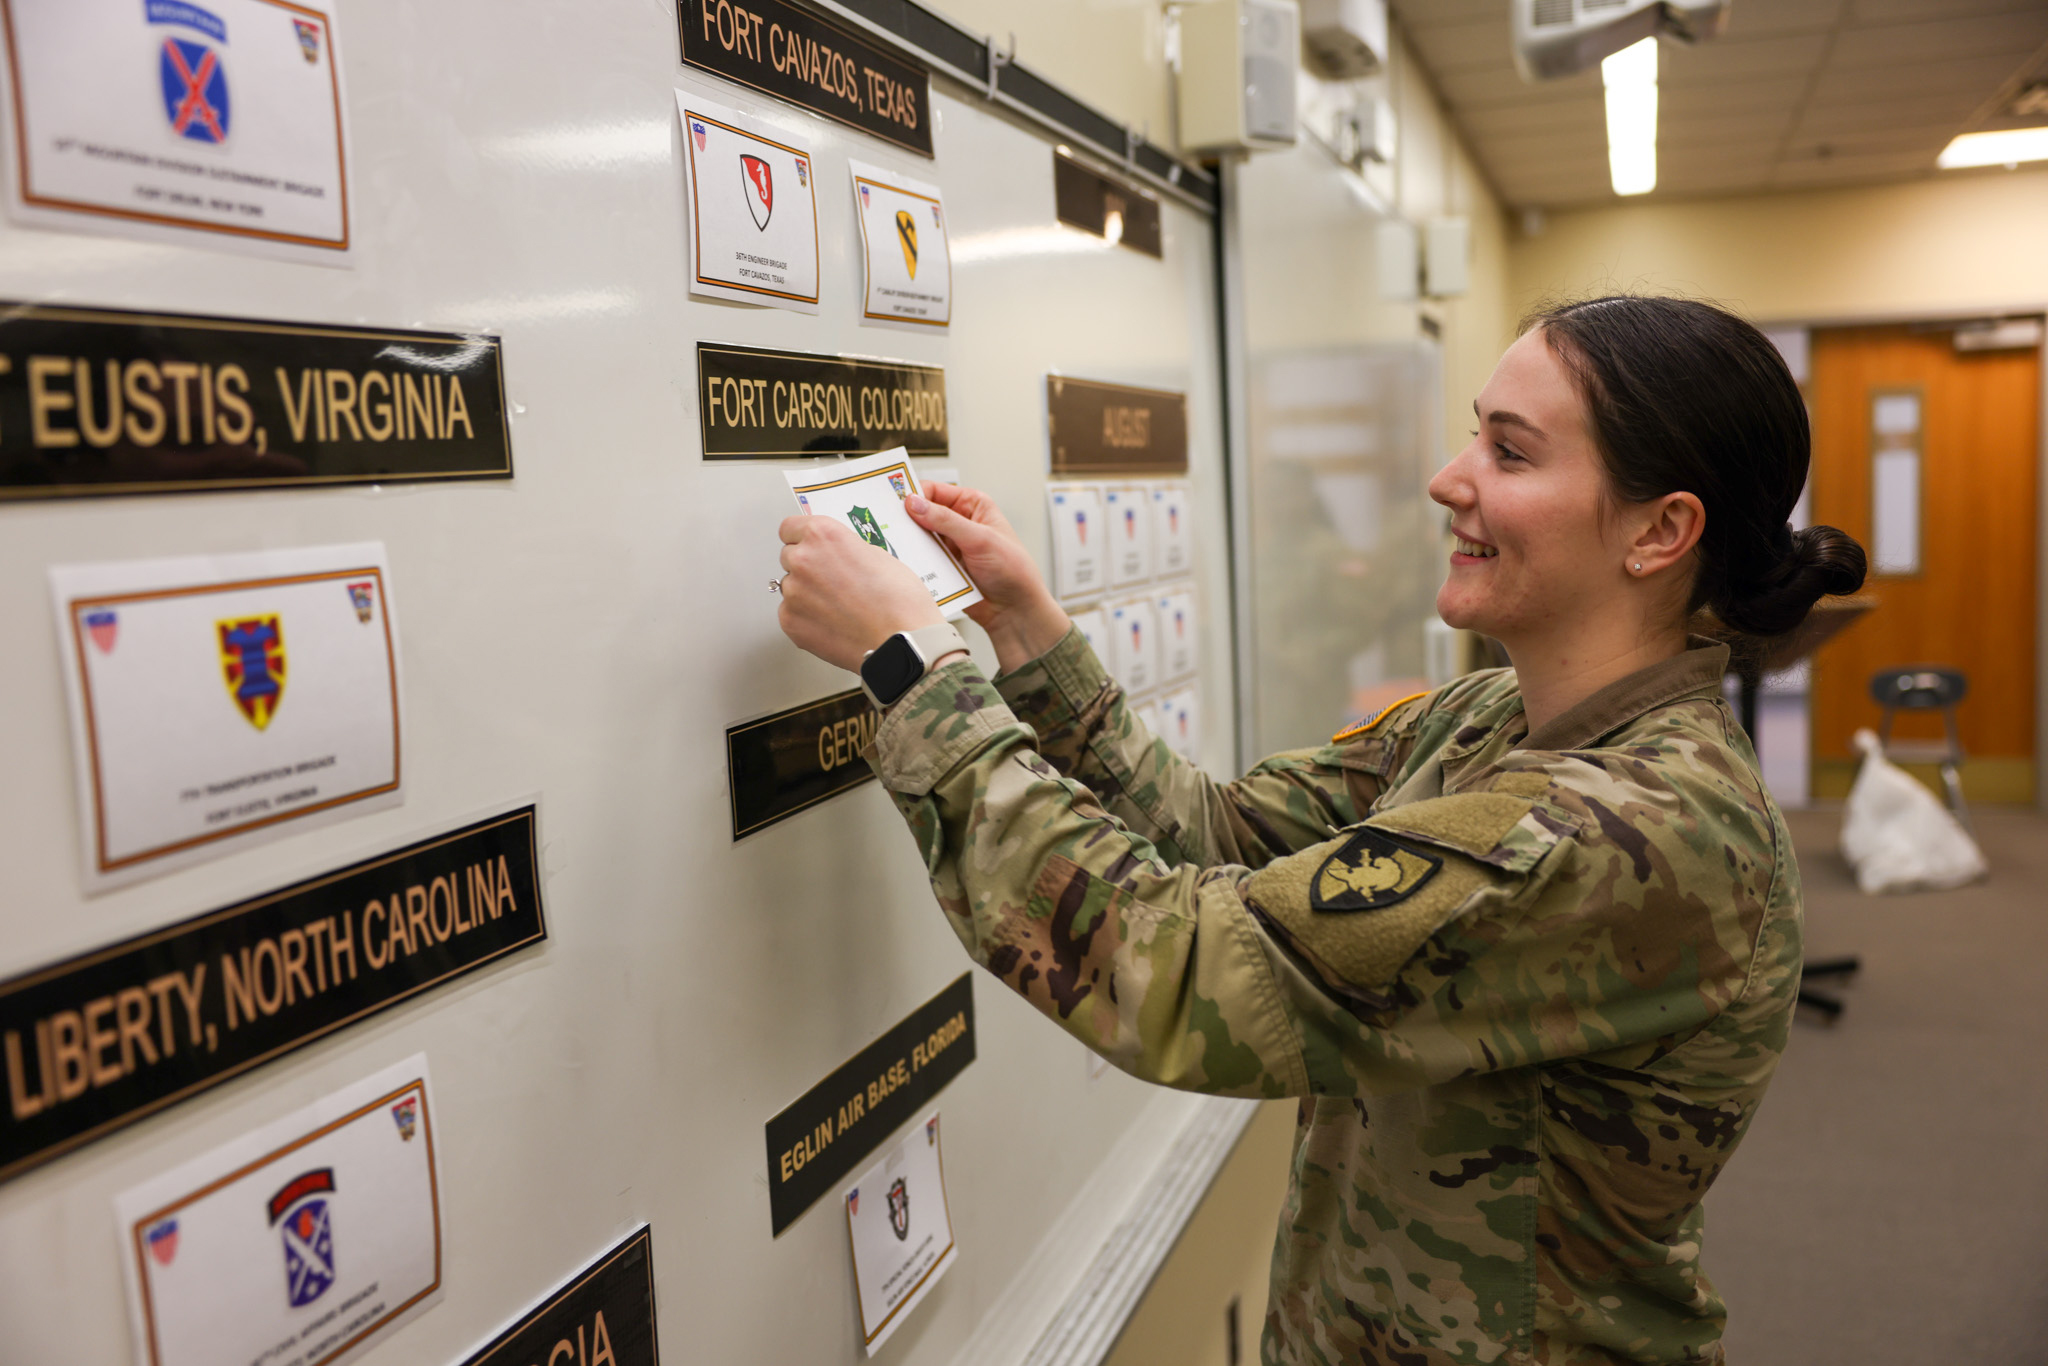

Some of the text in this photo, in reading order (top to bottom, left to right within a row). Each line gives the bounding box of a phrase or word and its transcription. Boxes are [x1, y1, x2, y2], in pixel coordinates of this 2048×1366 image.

[702, 0, 917, 130] FORT CAVAZOS, TEXAS
[739, 268, 751, 277] FORT
[771, 274, 785, 284] TEXAS
[747, 254, 769, 266] ENGINEER
[769, 259, 788, 270] BRIGADE
[27, 354, 268, 456] EUSTIS,
[276, 366, 475, 443] VIRGINIA
[708, 376, 944, 436] FORT CARSON, COLORADO
[1103, 406, 1151, 448] AUGUST
[4, 854, 517, 1121] LIBERTY, NORTH CAROLINA
[780, 1011, 967, 1183] EGLIN AIR BASE, FLORIDA
